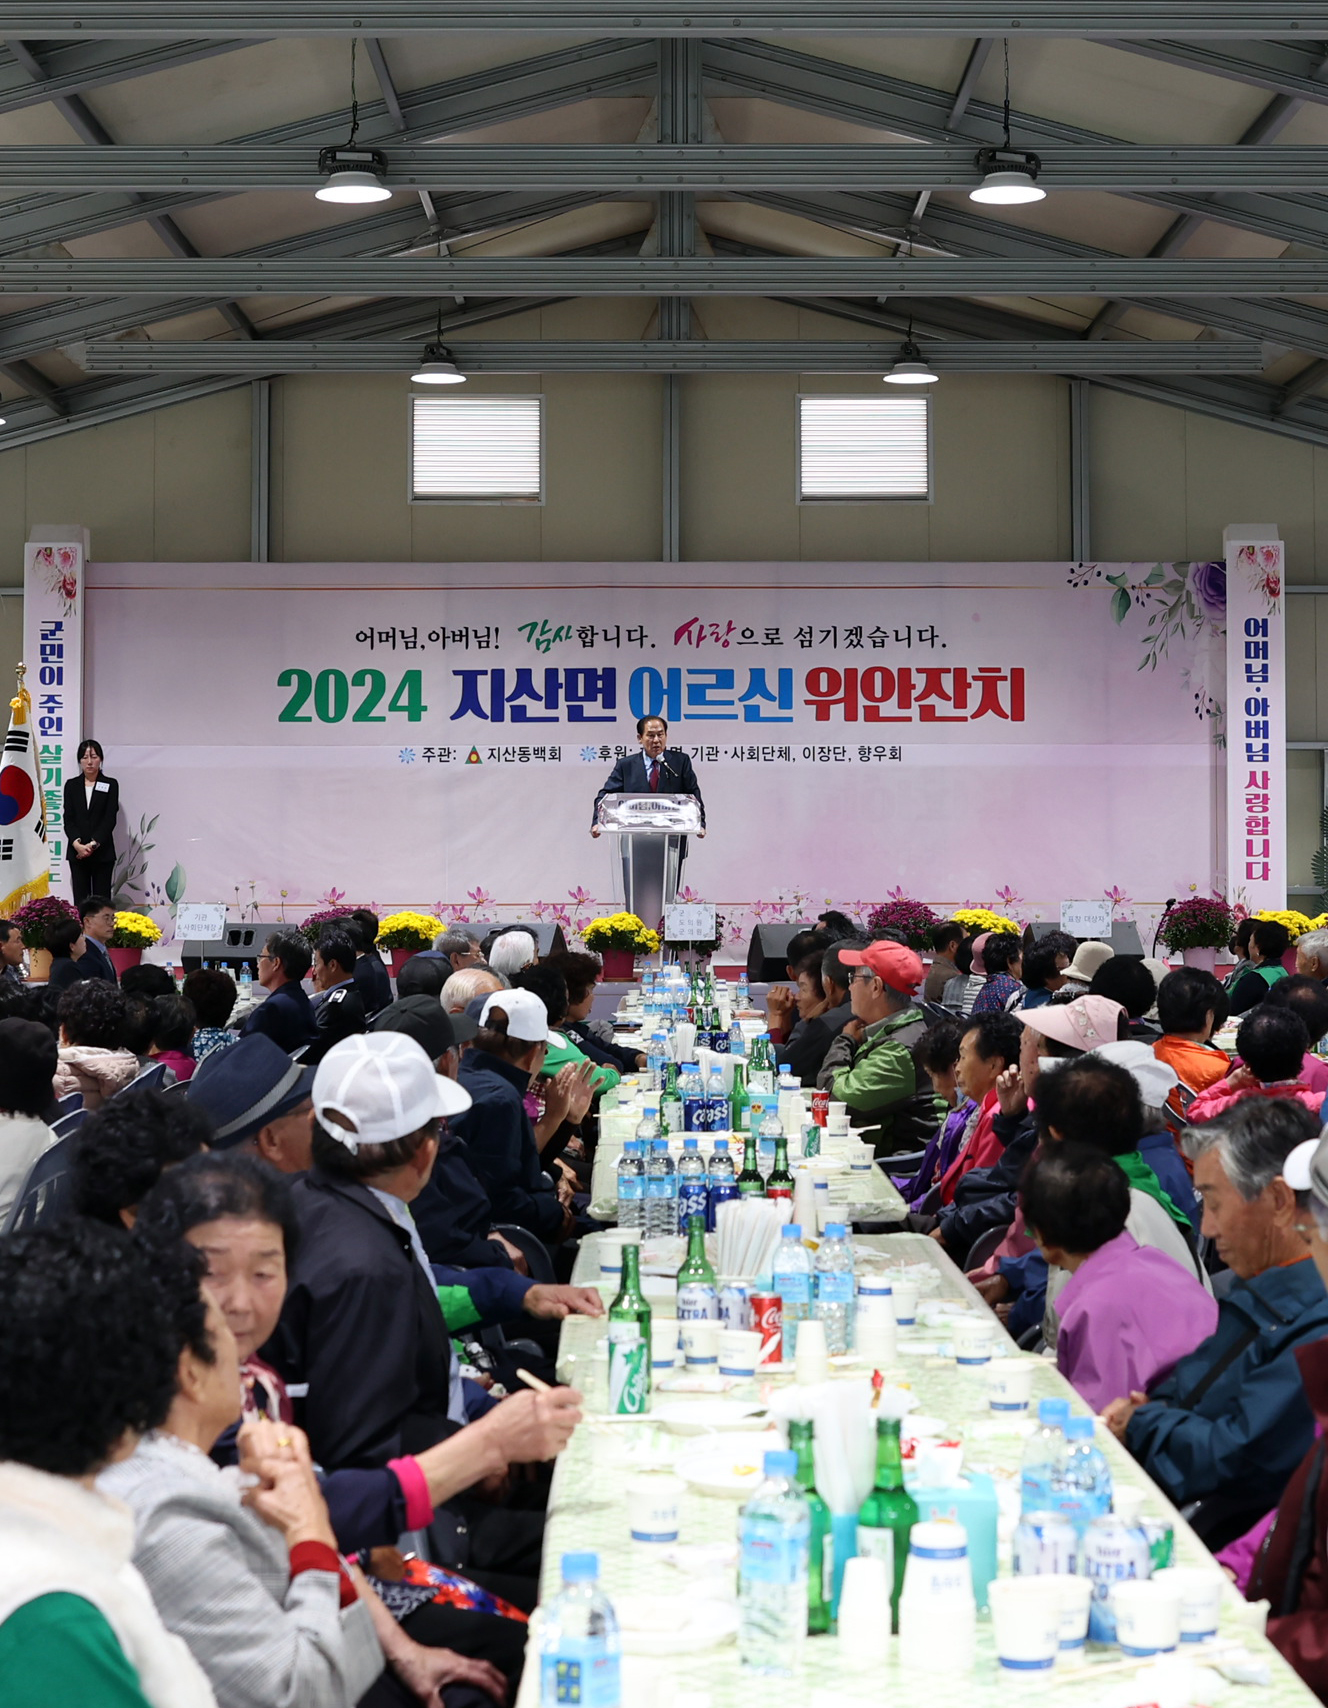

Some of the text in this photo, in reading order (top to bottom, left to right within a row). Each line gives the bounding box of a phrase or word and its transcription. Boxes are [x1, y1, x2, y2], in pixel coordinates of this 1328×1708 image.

[38, 620, 65, 686] 군민이
[517, 619, 656, 654] 감사합니다.
[673, 617, 784, 649] 사랑으로
[793, 624, 948, 649] 섬기겠습니다.
[38, 694, 64, 737] 주인
[276, 665, 1025, 723] 2024 지산면 어르신 위안잔치
[421, 746, 457, 763] 주관:
[487, 745, 562, 763] 지산동백회
[802, 745, 851, 763] 이장단,
[857, 745, 903, 762] 향우회
[1244, 770, 1271, 881] 사랑합니다
